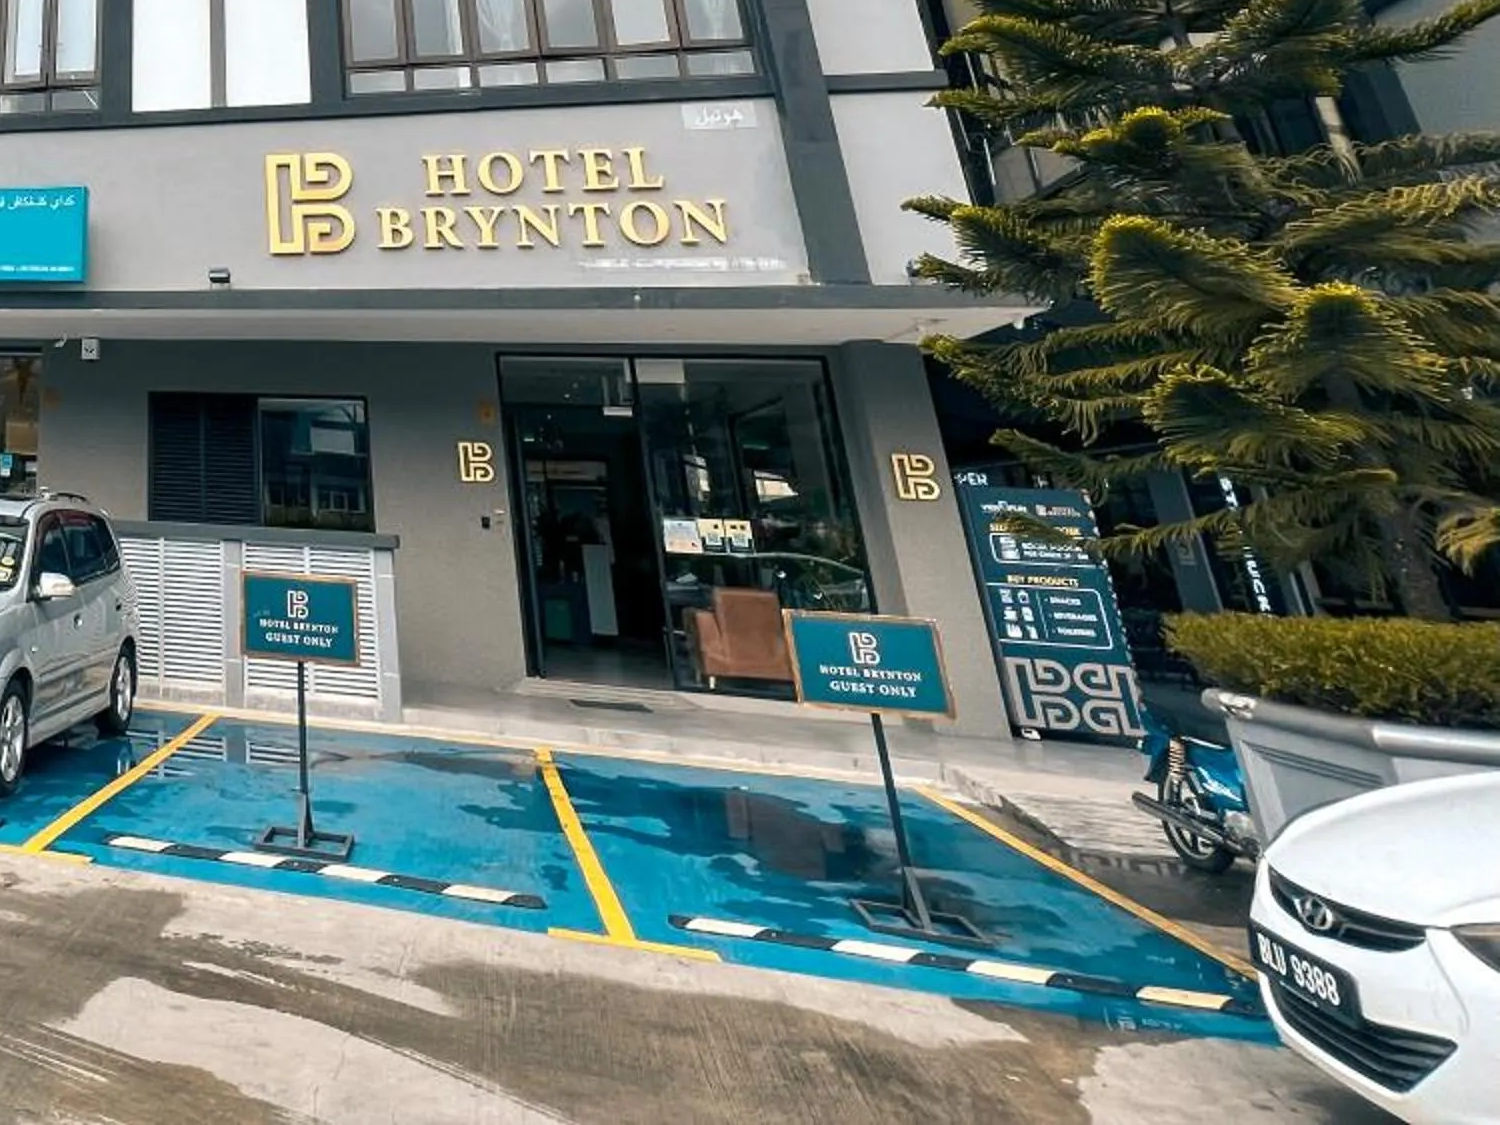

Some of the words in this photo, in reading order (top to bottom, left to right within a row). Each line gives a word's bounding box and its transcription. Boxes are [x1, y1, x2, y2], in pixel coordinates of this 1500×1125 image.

[421, 146, 665, 196] HOTEL
[375, 199, 727, 250] BRYNTON
[259, 618, 290, 630] HOTEL
[265, 632, 301, 645] GUEST
[303, 635, 333, 648] ONLY
[819, 664, 860, 678] HOTEL
[863, 668, 922, 682] BRYNTON
[829, 680, 875, 695] GUEST
[879, 683, 917, 698] ONLY
